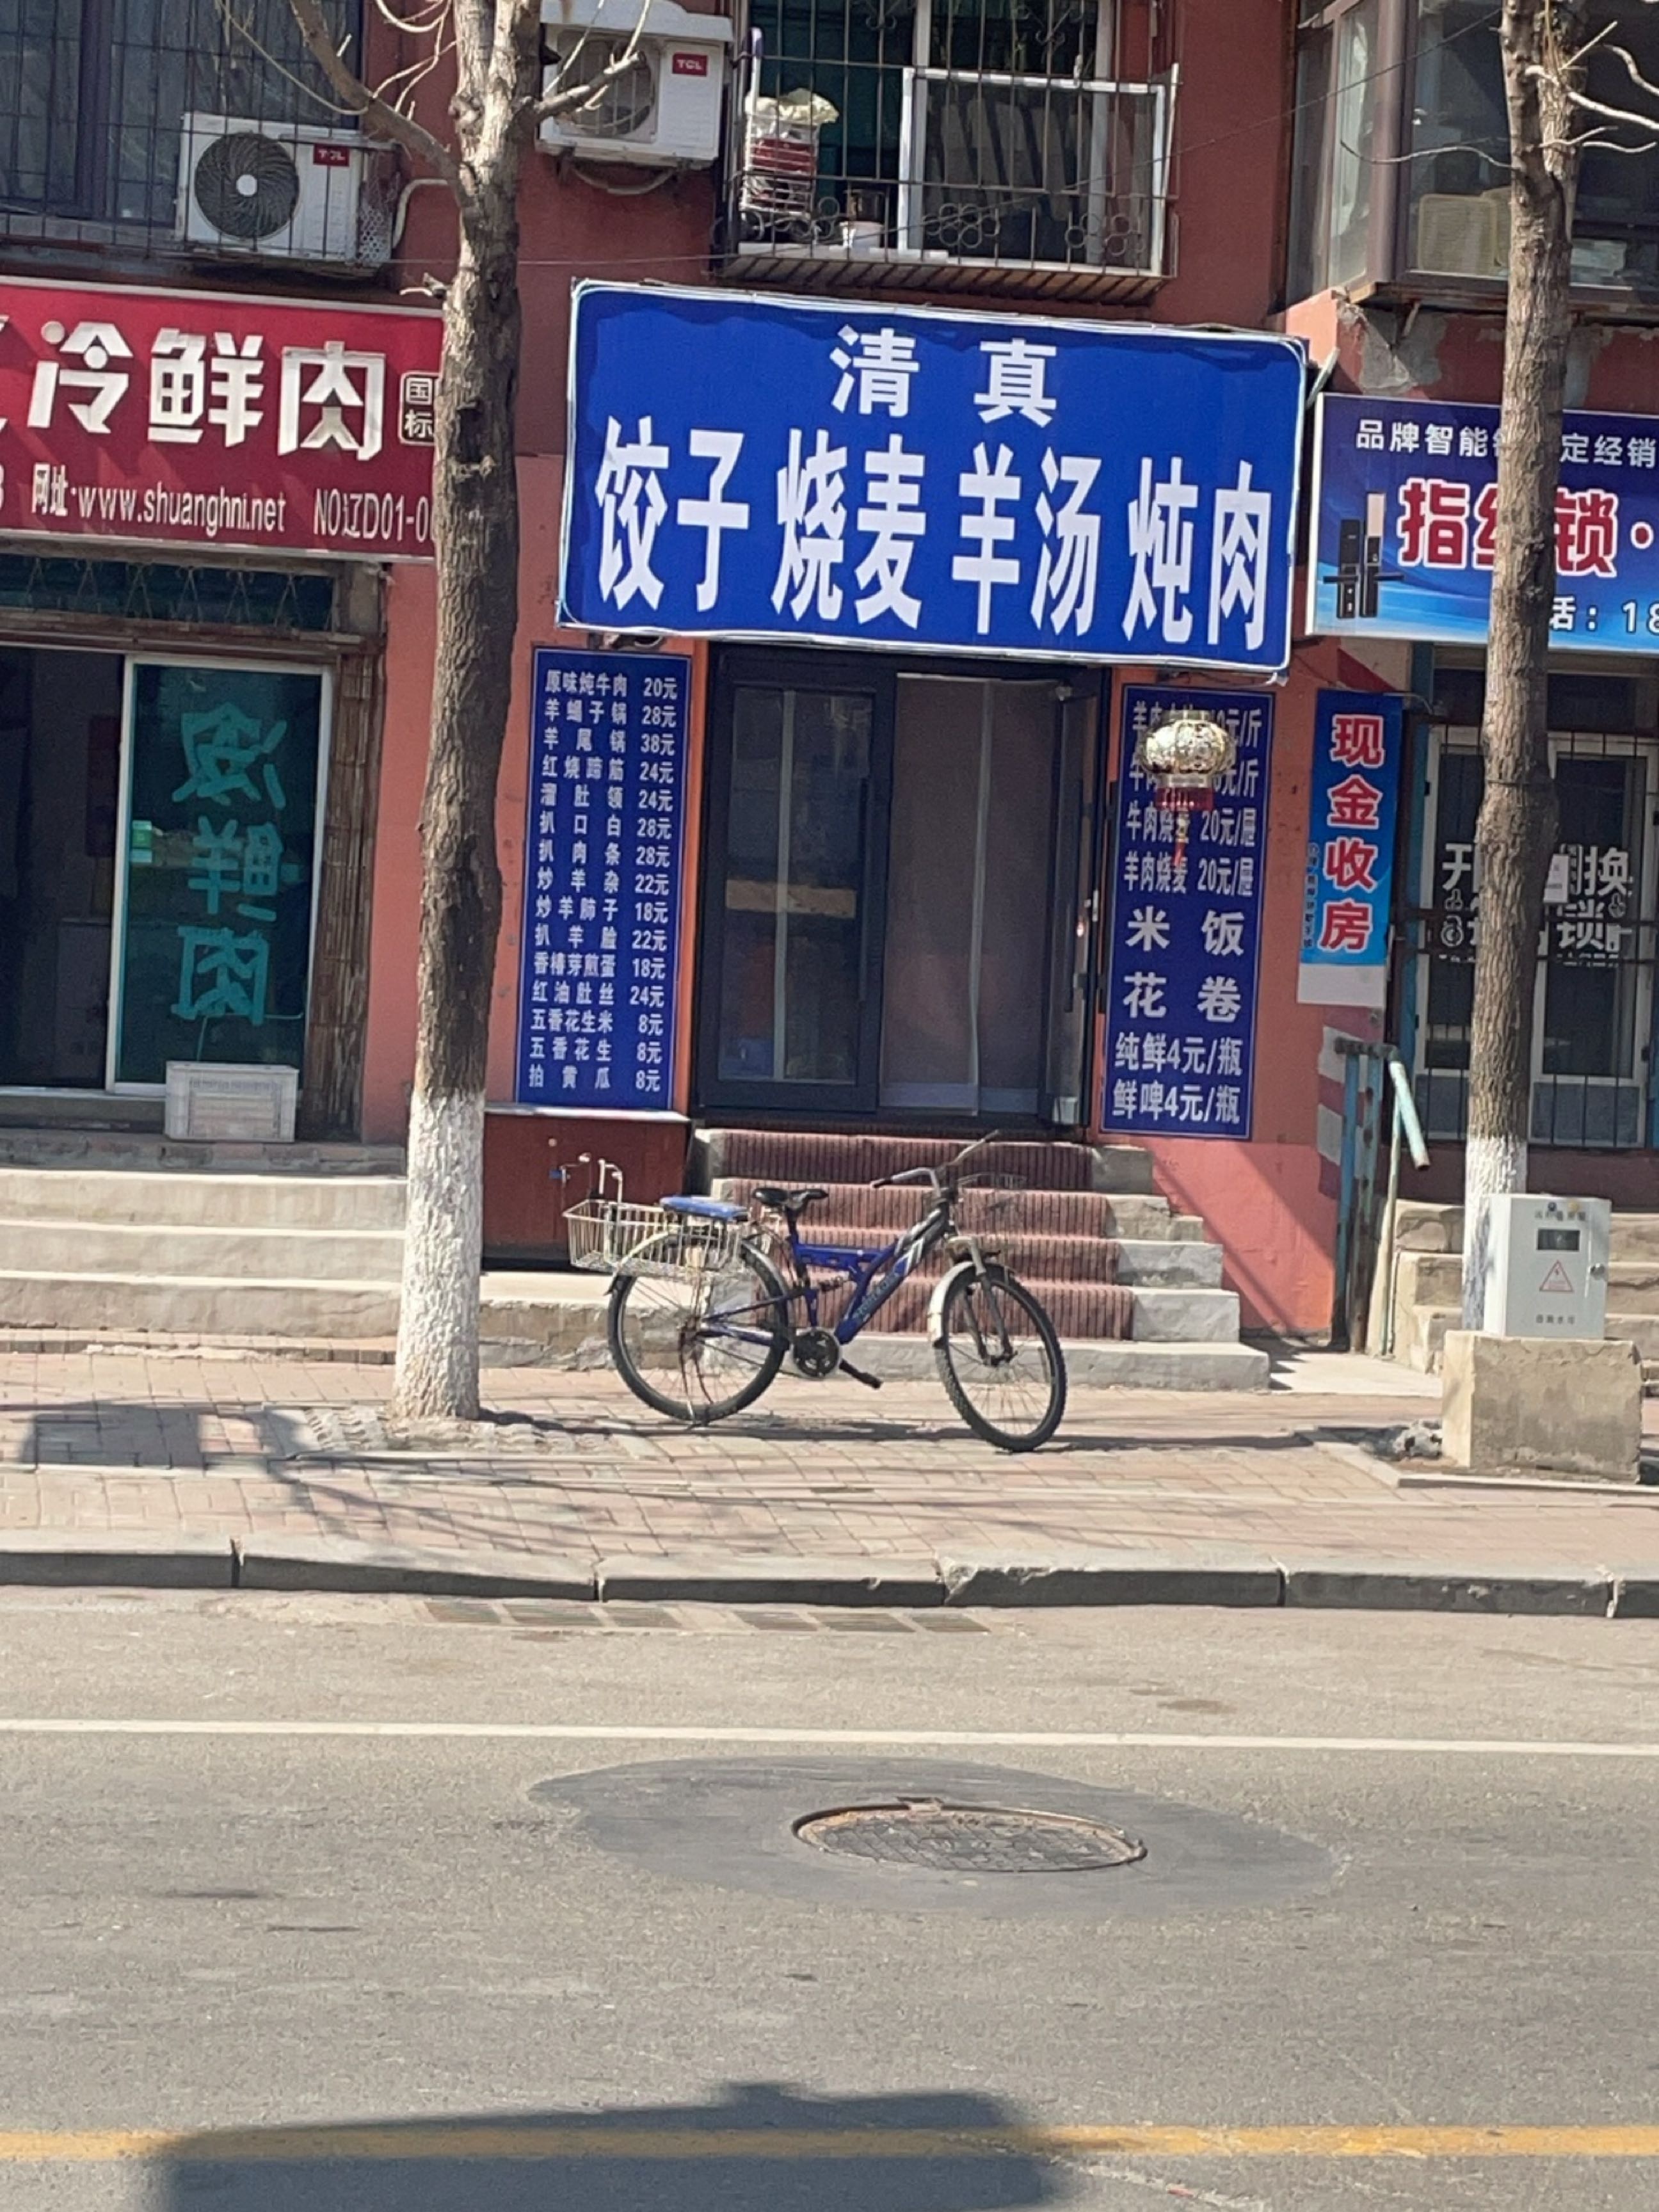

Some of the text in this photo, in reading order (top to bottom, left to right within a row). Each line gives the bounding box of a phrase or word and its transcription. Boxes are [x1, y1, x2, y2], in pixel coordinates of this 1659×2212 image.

[676, 59, 703, 70] TCL
[0, 316, 386, 462] 冷鲜肉
[829, 325, 1057, 427] 清真
[404, 377, 433, 438] 国标
[1355, 419, 1657, 469] 品牌智能定经销
[313, 488, 434, 543] NO辽D01-0
[595, 416, 1272, 651] 饺子 烧麦 羊汤 炖肉
[545, 669, 677, 700] 原味炖牛肉 20元
[641, 705, 677, 728] 28元
[543, 726, 675, 756] 羊尾锅 38元
[639, 761, 674, 784] 24元
[639, 789, 673, 812] 24元
[540, 810, 672, 840] 扒口白 28元
[1318, 712, 1385, 953] 现金收房
[539, 838, 670, 867] 扒肉条 28元
[537, 867, 669, 895] 炒羊杂 22元
[635, 901, 668, 924] 18元
[632, 929, 667, 952] 22元
[1125, 905, 1246, 957] 米饭
[632, 958, 666, 979] 18元
[532, 980, 664, 1007] 红油肚丝 24元
[1122, 971, 1242, 1023] 花卷
[531, 1008, 663, 1036] 五香花生米 8元
[529, 1036, 662, 1064] 五香花生 8元
[1114, 1030, 1244, 1077] 纯鲜4元/瓶
[529, 1064, 661, 1092] 拍黄瓜 8元
[1112, 1078, 1241, 1125] 鲜啤4元/瓶
